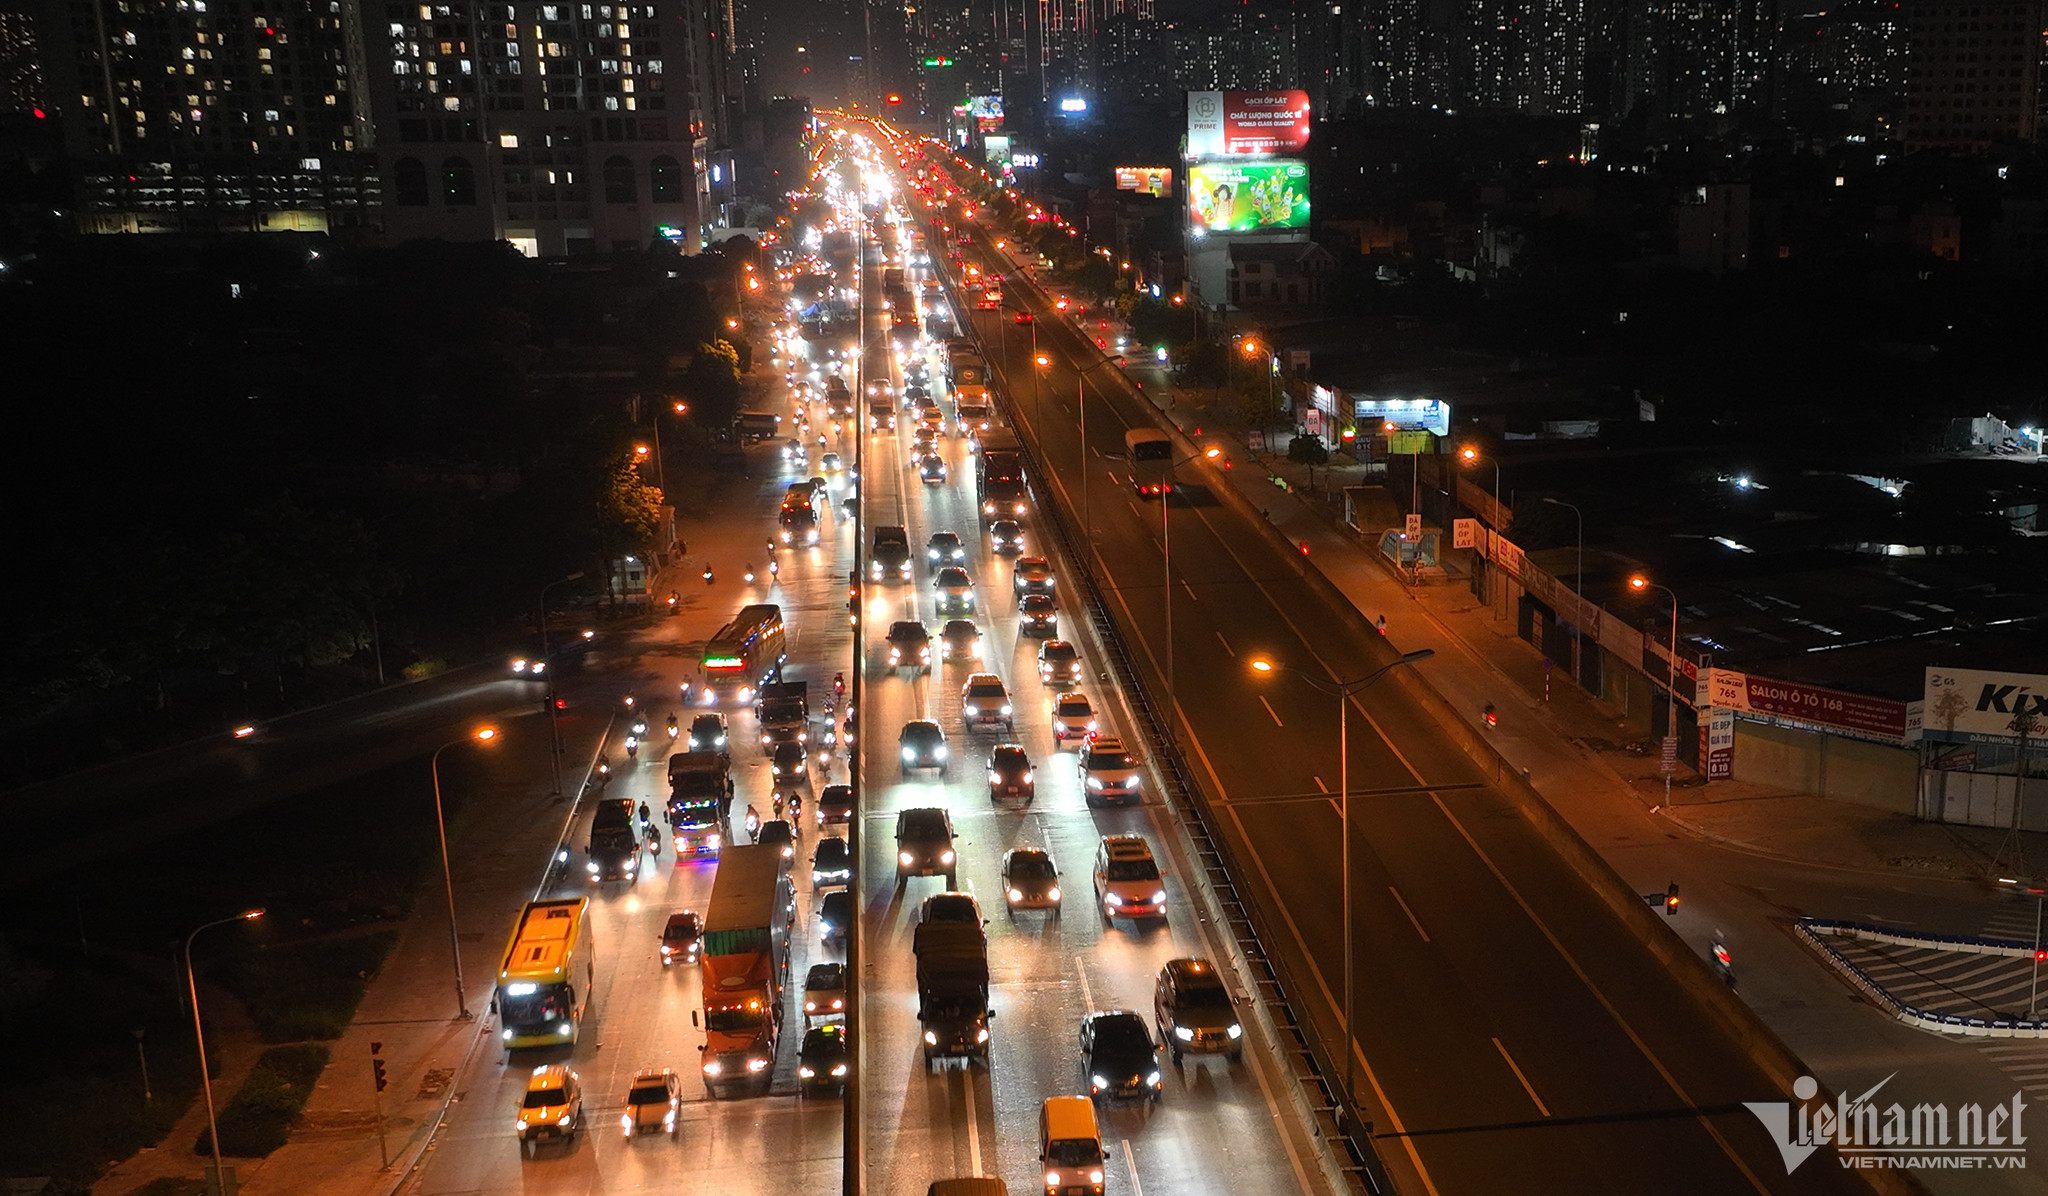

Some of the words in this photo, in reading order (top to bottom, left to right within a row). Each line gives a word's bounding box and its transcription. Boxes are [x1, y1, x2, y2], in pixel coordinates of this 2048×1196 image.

[1274, 96, 1288, 104] LÁT
[1944, 678, 1955, 686] GS
[1719, 687, 1736, 698] 765
[1750, 684, 1788, 702] SALON
[1790, 689, 1801, 703] Ô
[1803, 692, 1819, 707] TÔ
[1822, 697, 1843, 712] 168
[1712, 721, 1719, 730] XE
[1720, 720, 1731, 731] ĐẸP
[1908, 718, 1922, 727] 765
[1711, 735, 1720, 744] GIÁ
[1711, 762, 1718, 773] Ô
[1718, 762, 1729, 772] TÔ
